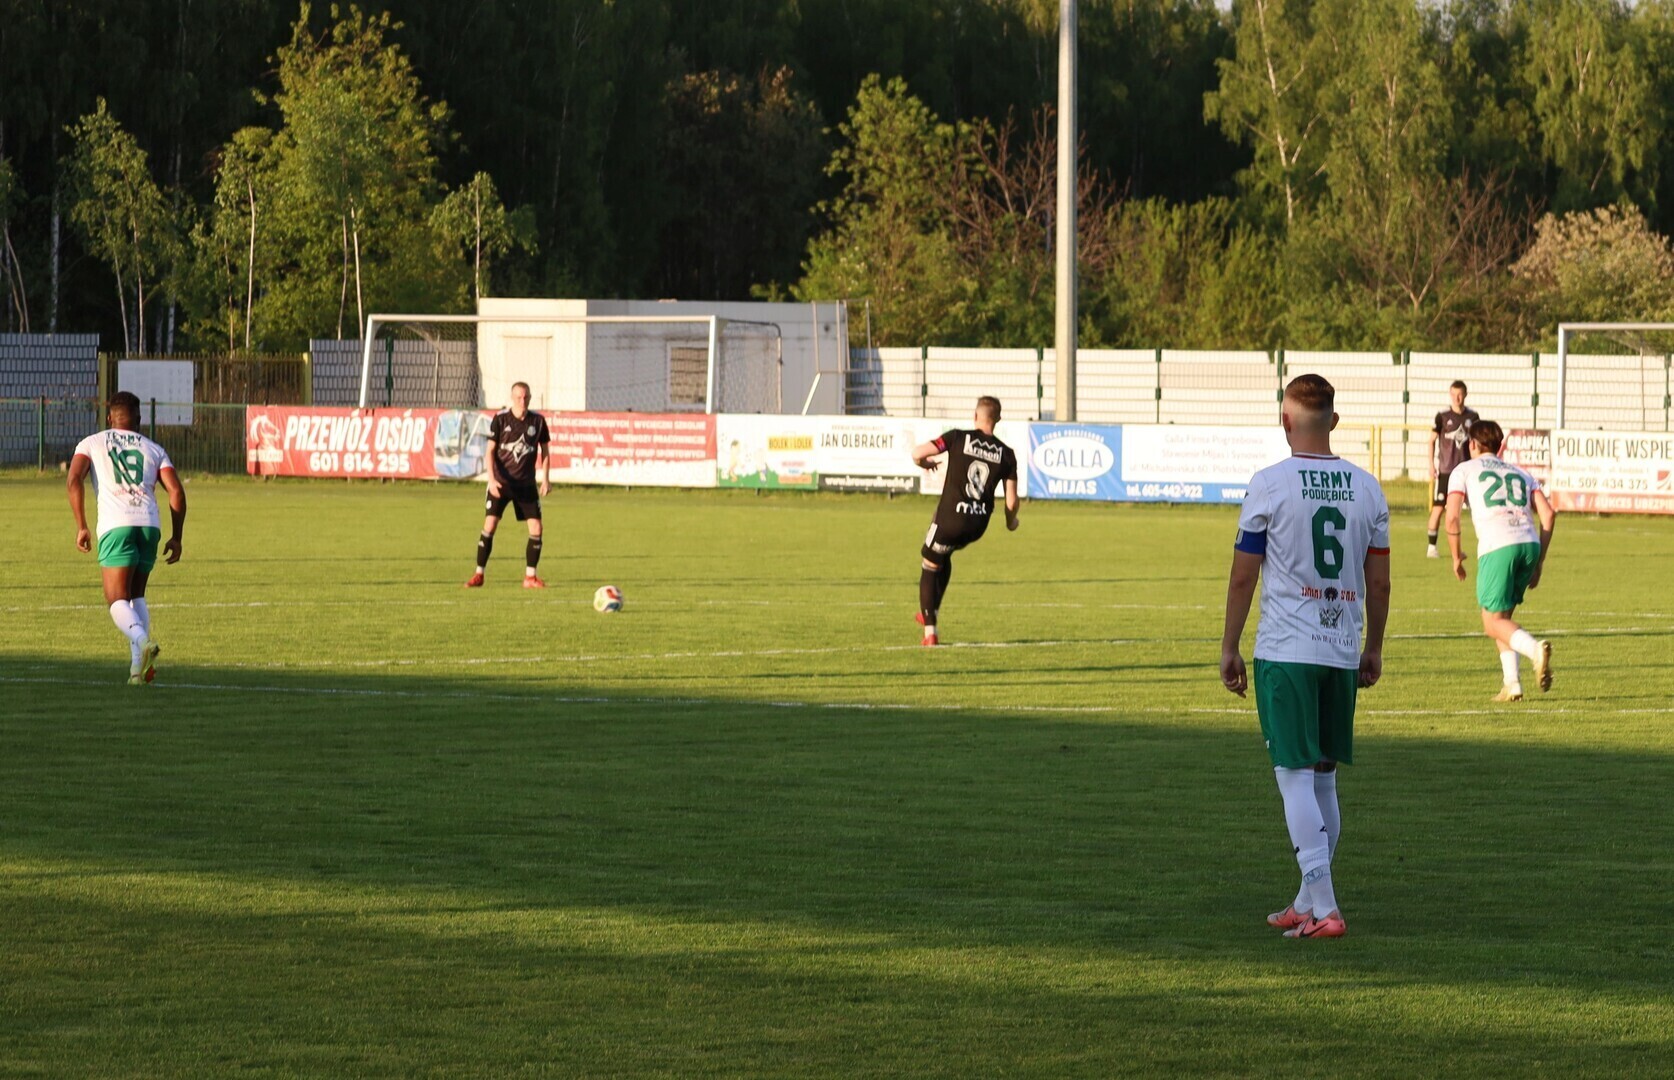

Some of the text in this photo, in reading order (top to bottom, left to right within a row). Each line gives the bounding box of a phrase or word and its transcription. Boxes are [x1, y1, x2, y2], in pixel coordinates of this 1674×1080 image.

[284, 408, 426, 453] PRZEWÓZ OSÓB
[1164, 434, 1184, 444] Calla
[768, 437, 788, 449] BOLEK
[794, 437, 813, 449] LOLEK
[820, 433, 895, 449] JAN OLBRACHT
[1506, 435, 1550, 450] GRAFIKA
[1557, 437, 1621, 462] POLONIĘ
[310, 452, 410, 473] 601 814 295
[1043, 447, 1103, 469] CALLA
[1503, 450, 1518, 464] NA
[108, 446, 144, 486] 19
[1048, 479, 1097, 495] MIJAS
[1298, 470, 1352, 489] TERMY
[1556, 477, 1648, 490] tel. 509 434 375
[1302, 489, 1355, 503] PODDĘBICE
[1479, 470, 1528, 508] 20
[1312, 505, 1346, 579] 6
